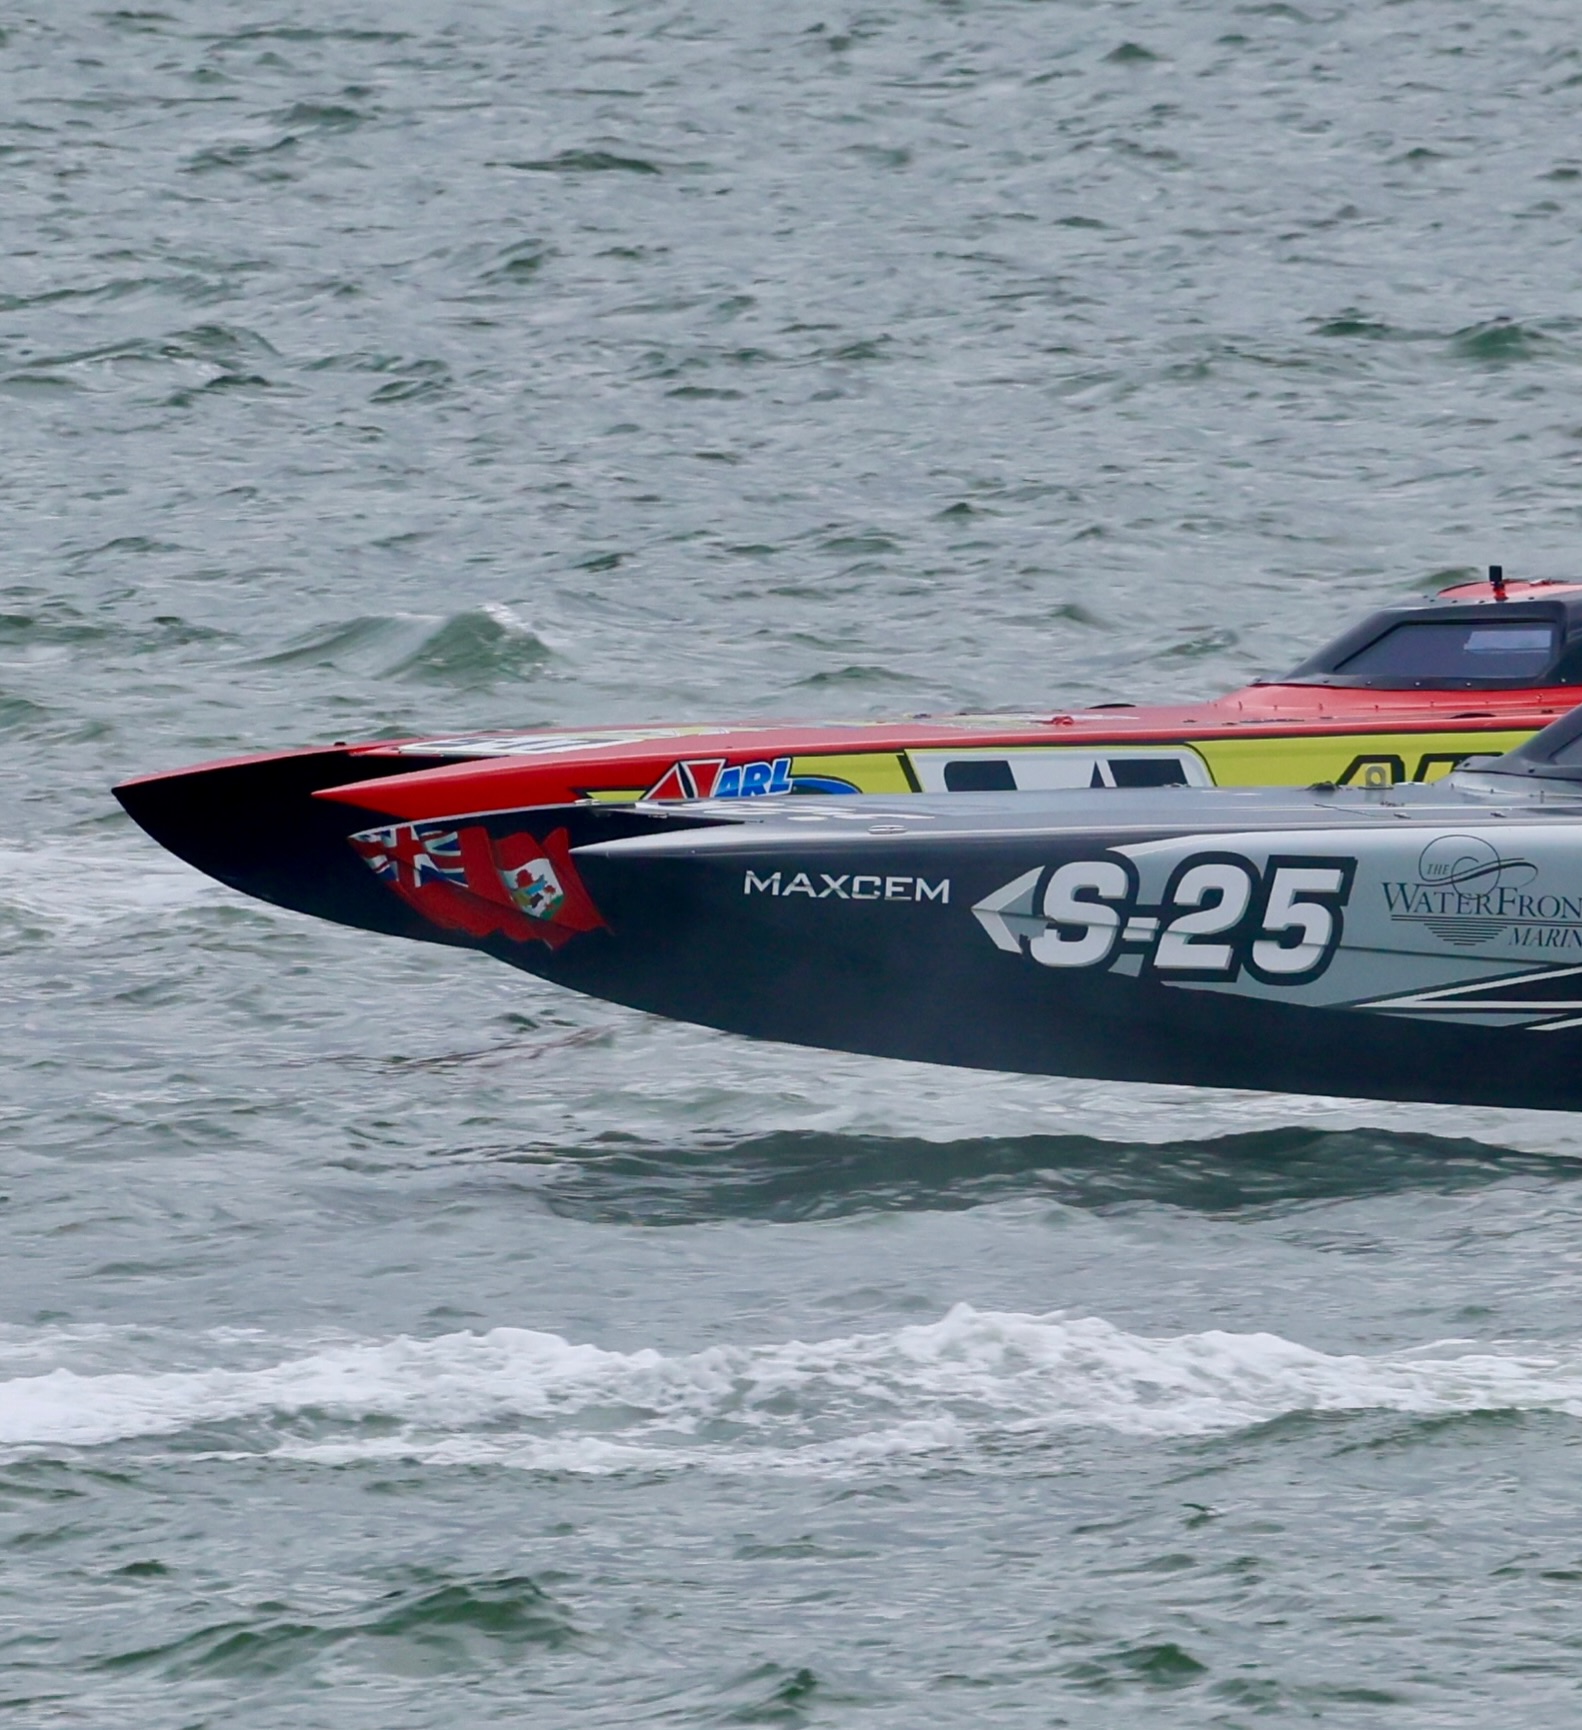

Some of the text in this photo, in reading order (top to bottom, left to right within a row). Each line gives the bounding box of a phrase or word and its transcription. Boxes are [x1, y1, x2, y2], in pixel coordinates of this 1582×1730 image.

[1427, 863, 1450, 876] THE
[743, 870, 950, 904] MAXCEM
[1028, 856, 1352, 976] S-25
